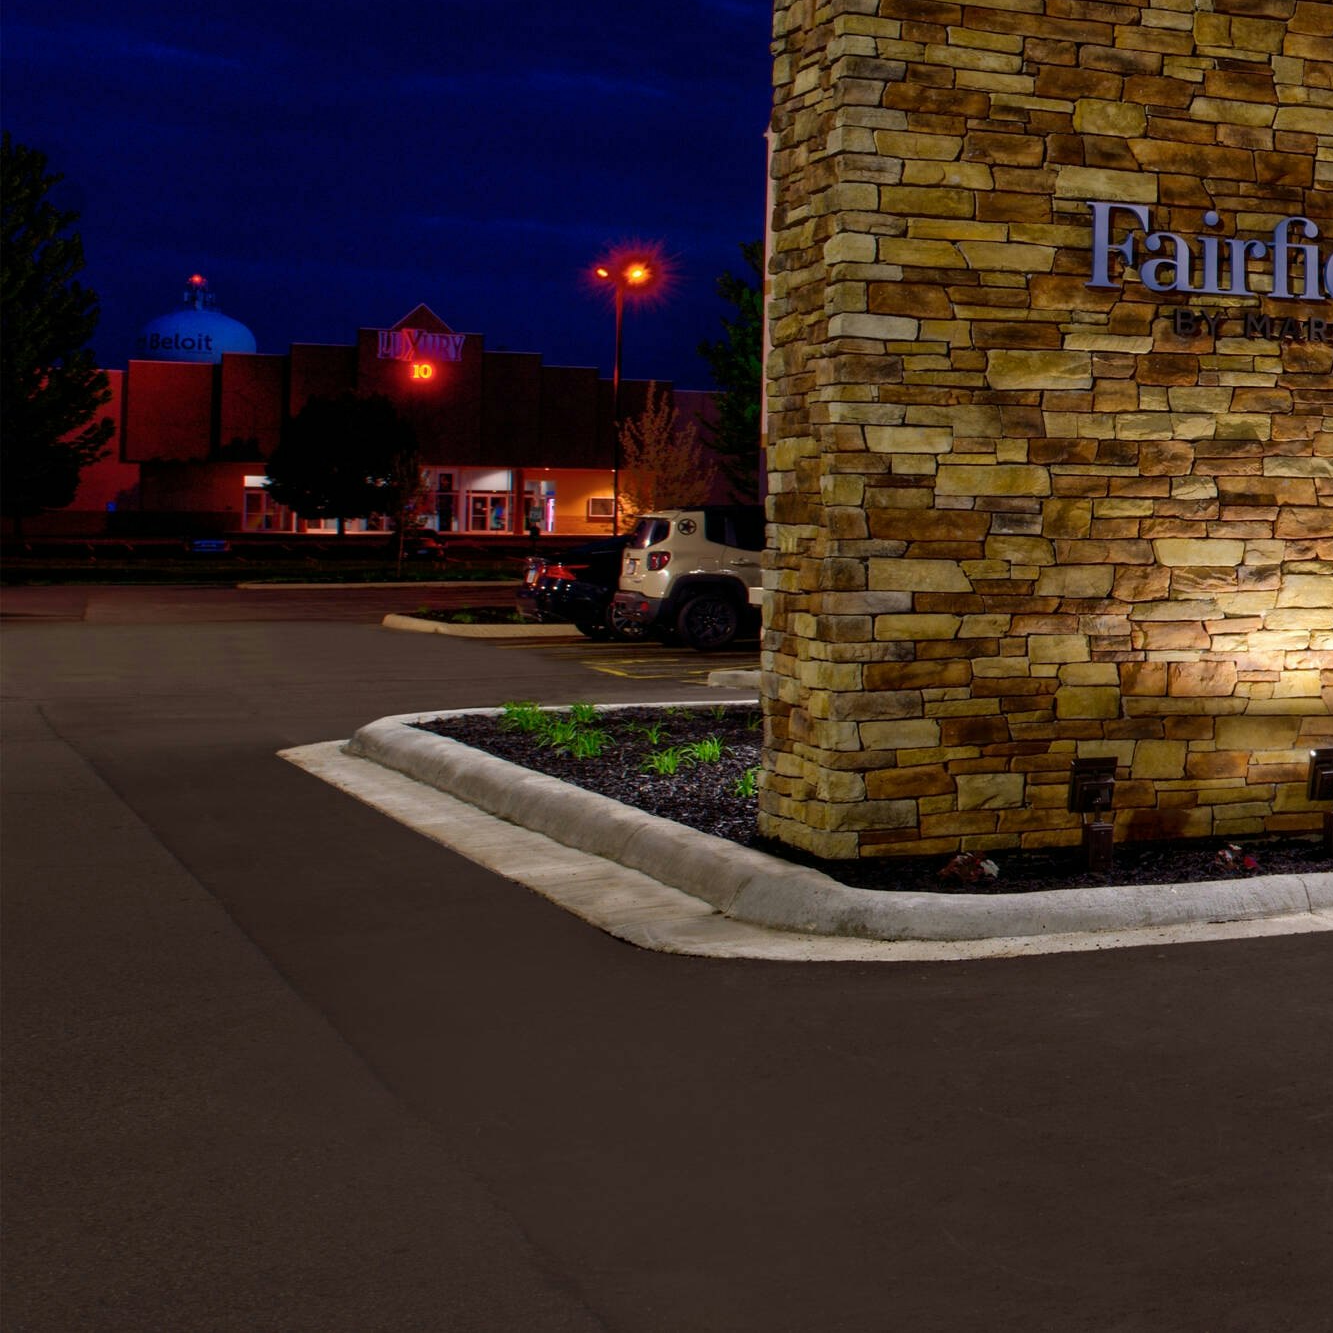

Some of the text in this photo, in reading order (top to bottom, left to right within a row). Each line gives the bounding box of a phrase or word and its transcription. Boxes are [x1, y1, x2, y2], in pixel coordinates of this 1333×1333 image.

[1174, 307, 1223, 337] BY
[148, 333, 213, 351] Beloit
[377, 328, 465, 362] LUXURY
[412, 364, 433, 379] 10
